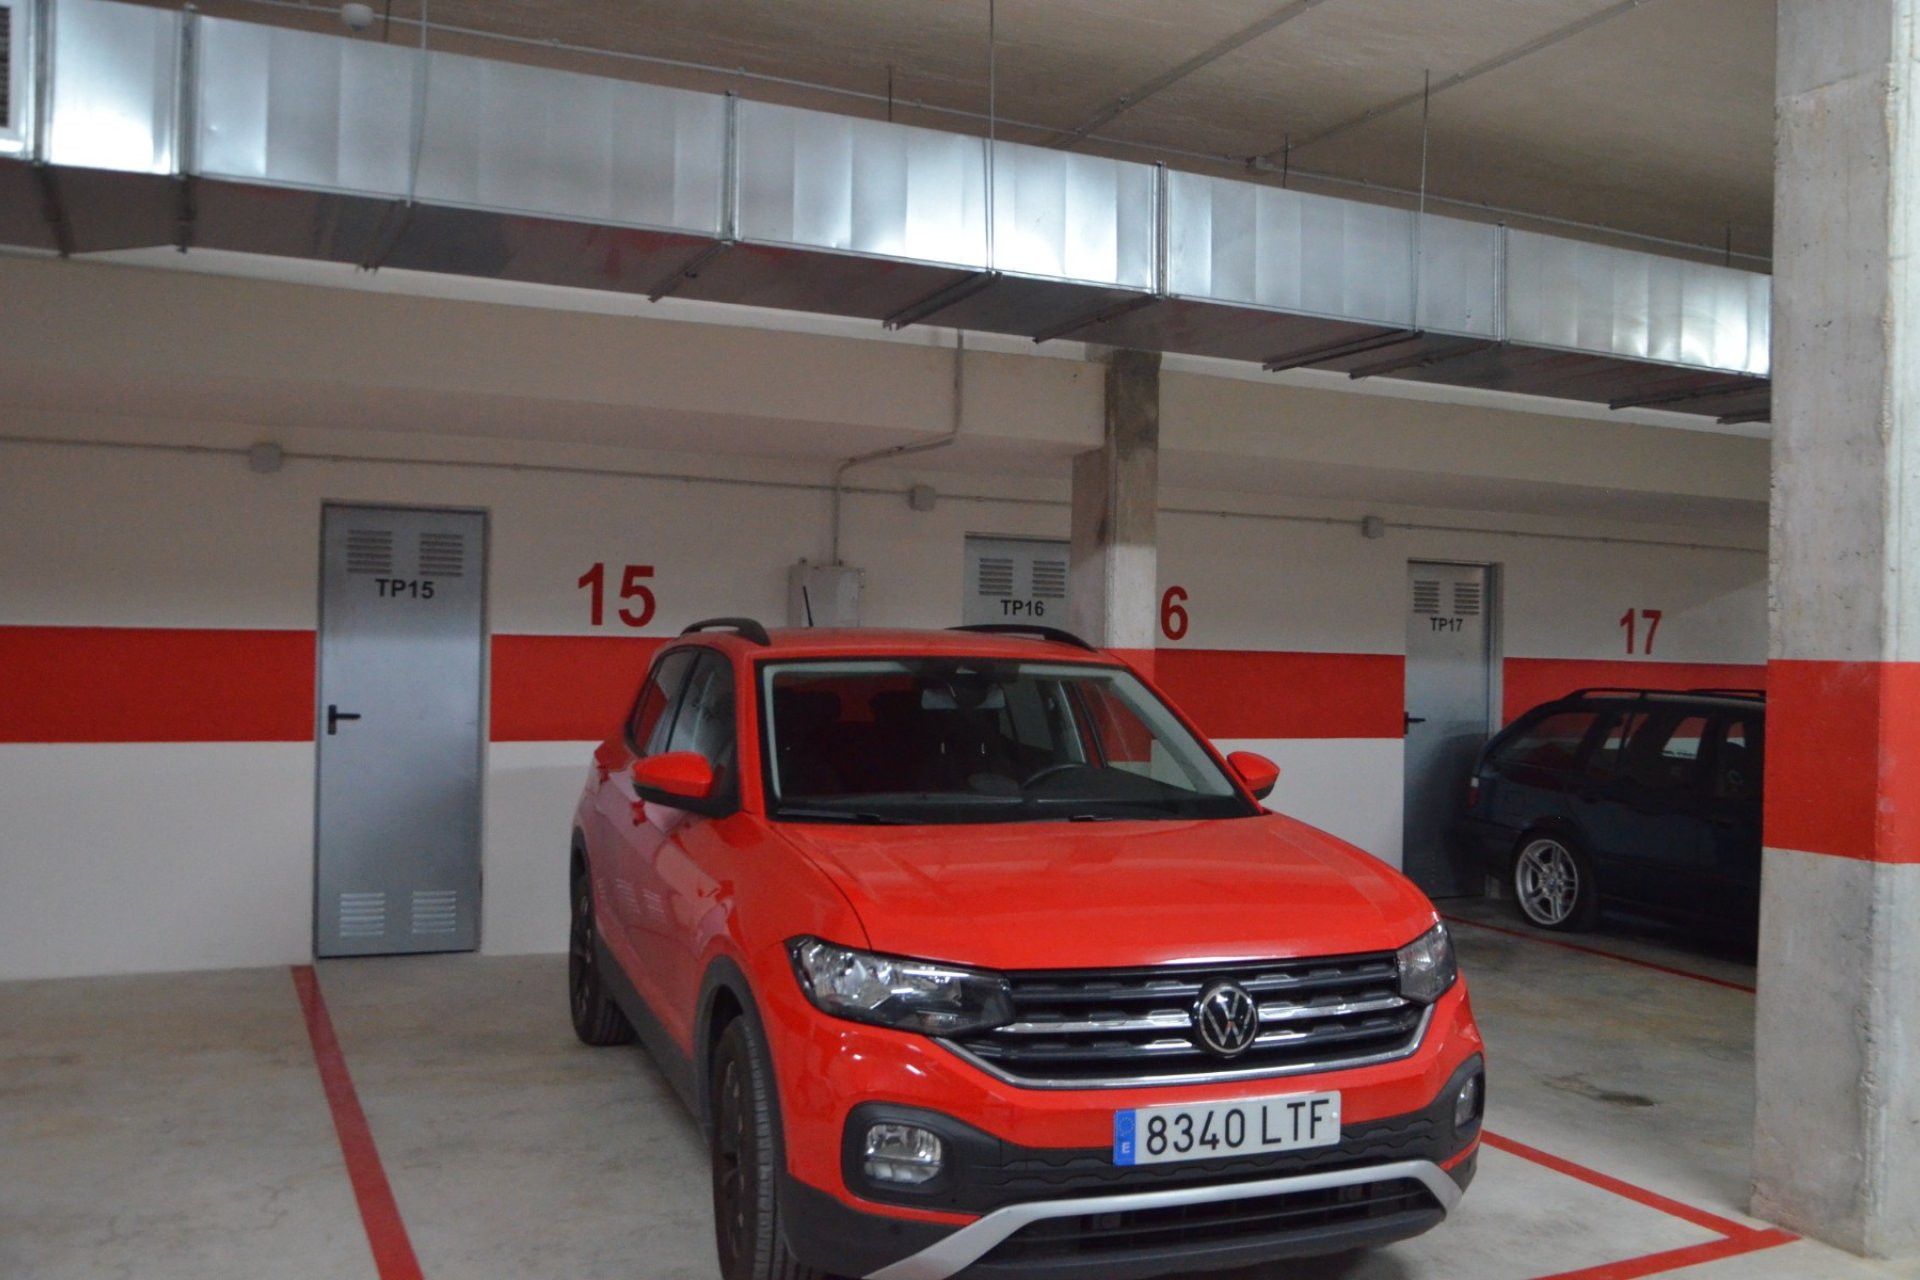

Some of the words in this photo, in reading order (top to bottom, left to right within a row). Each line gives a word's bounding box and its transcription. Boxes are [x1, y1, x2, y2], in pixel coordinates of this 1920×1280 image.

[375, 578, 434, 599] TP15
[578, 562, 656, 628] 15
[1000, 600, 1044, 617] TP16
[1430, 617, 1463, 633] TP17
[1620, 608, 1662, 655] 17
[1146, 1108, 1245, 1155] 8340
[1262, 1099, 1329, 1145] LTF
